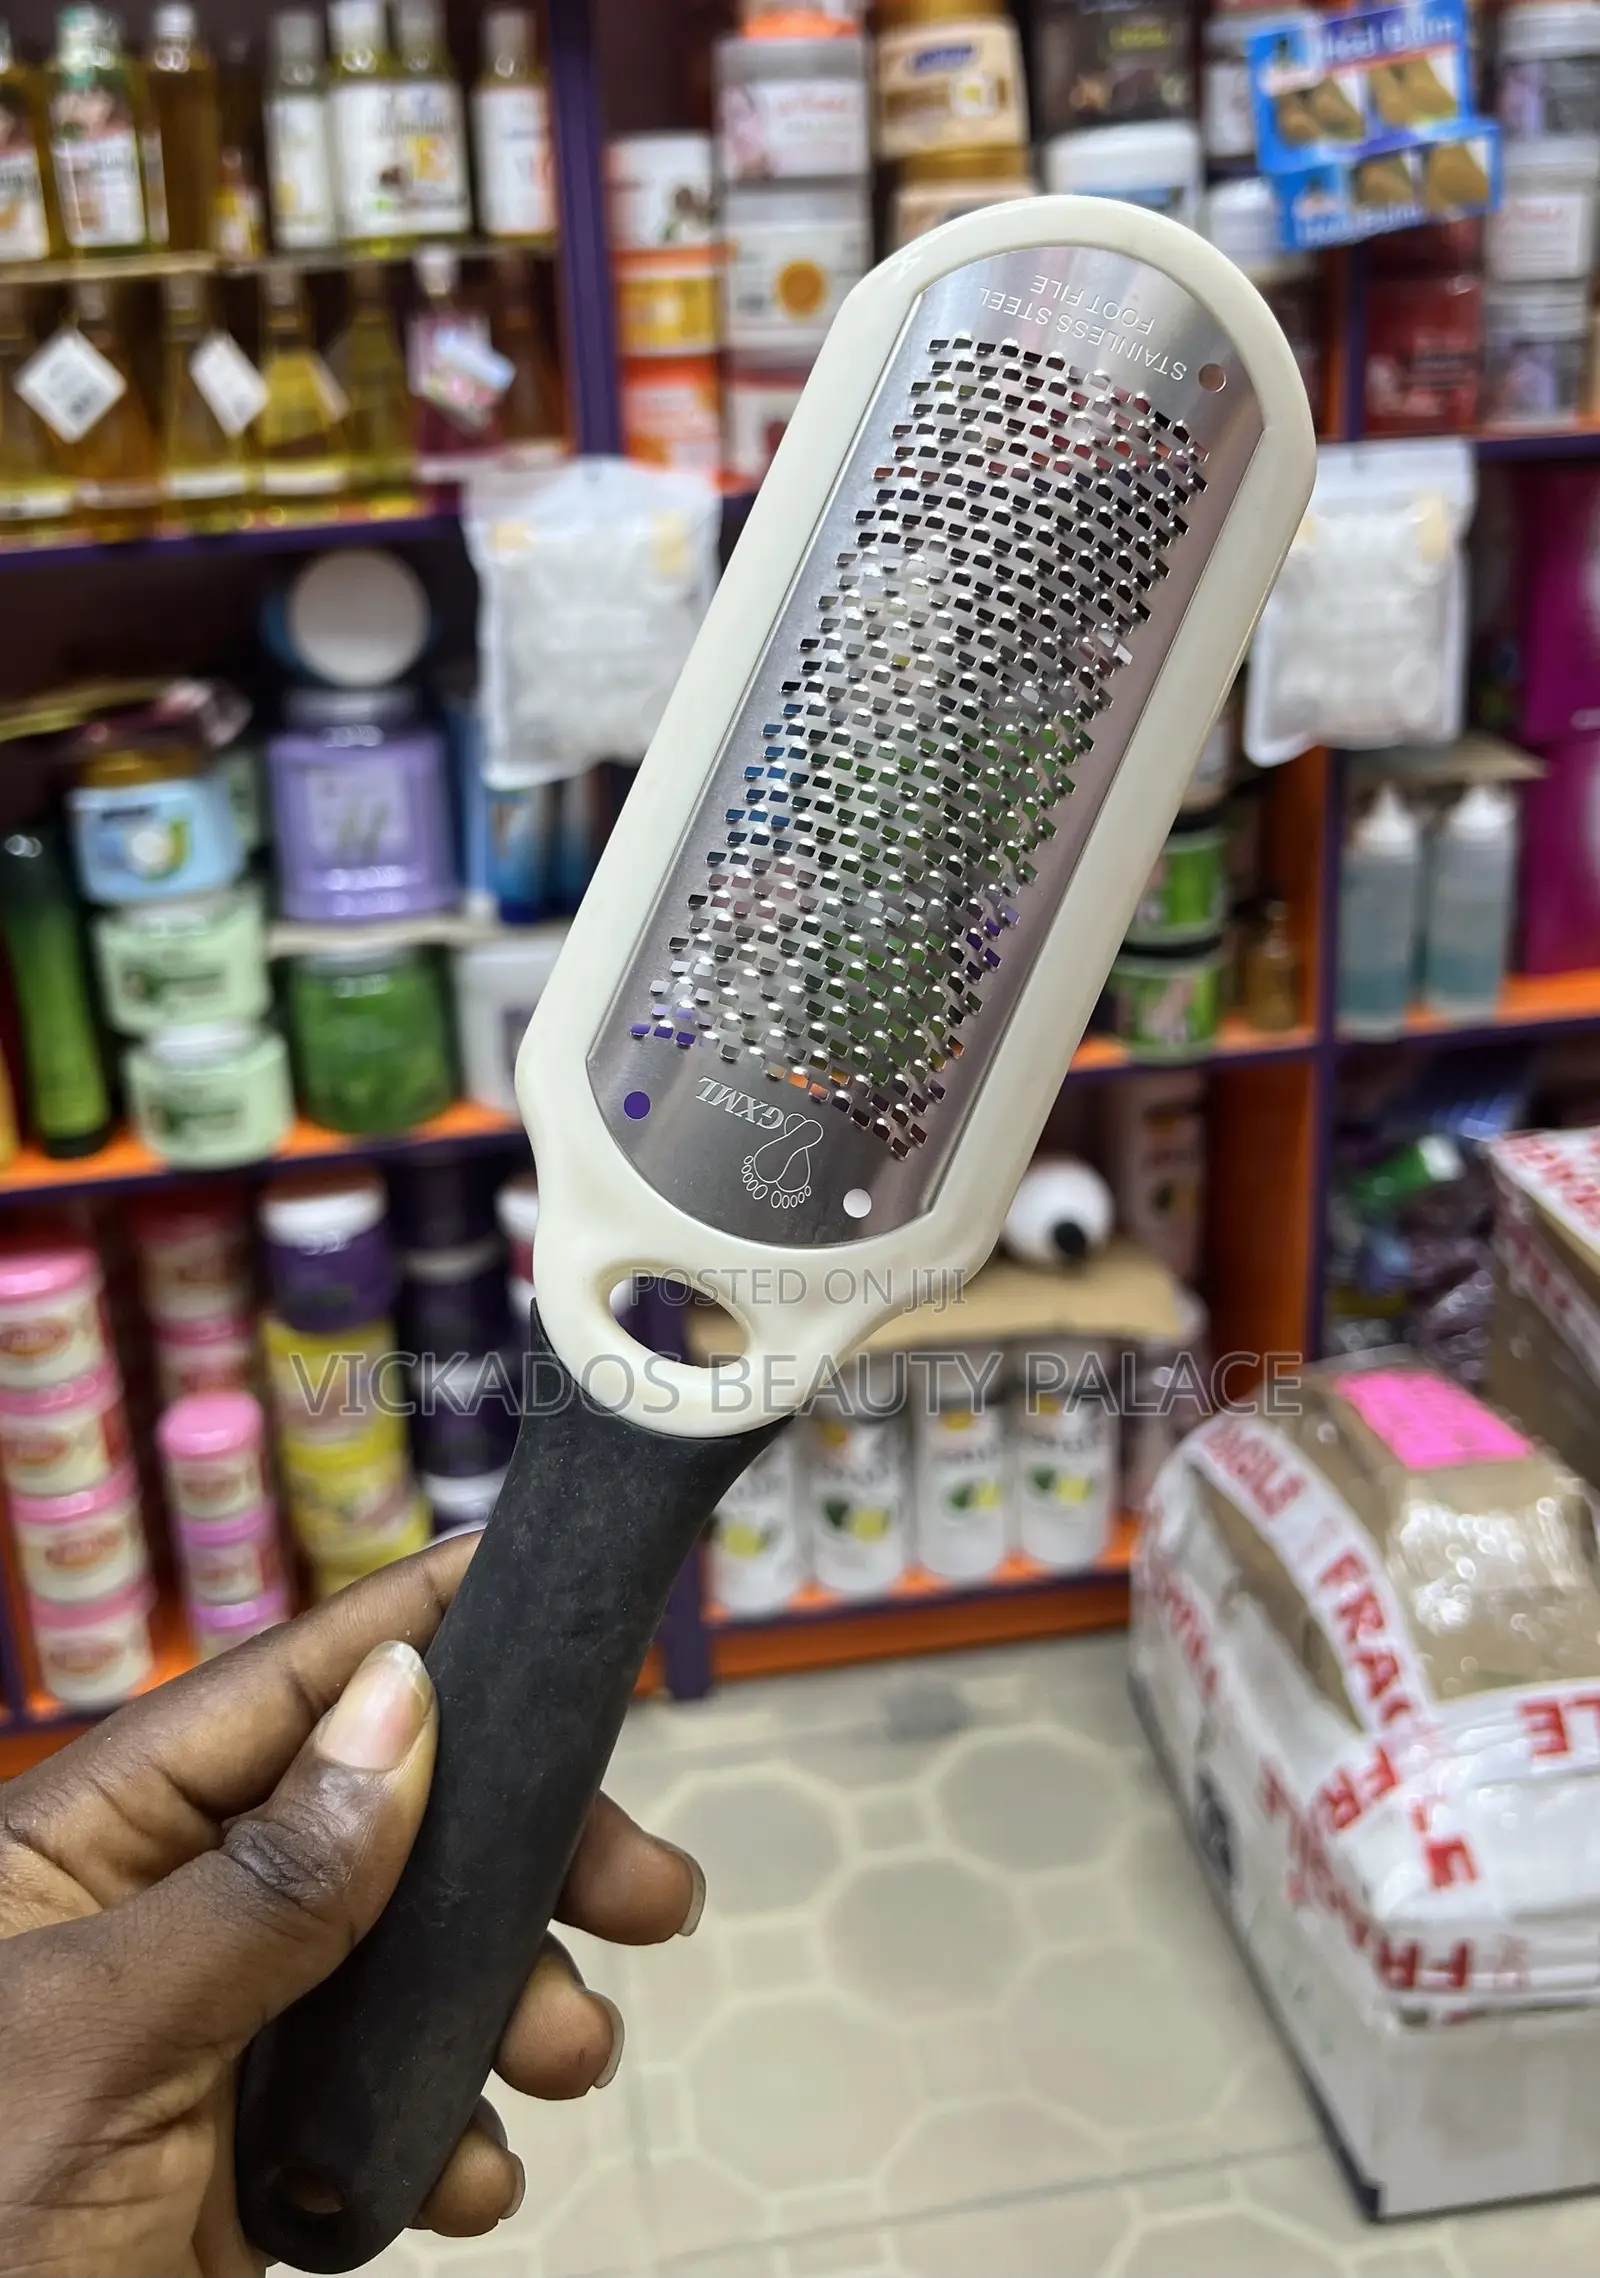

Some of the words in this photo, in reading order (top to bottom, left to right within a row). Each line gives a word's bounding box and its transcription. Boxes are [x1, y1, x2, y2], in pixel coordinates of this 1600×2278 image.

[979, 287, 1052, 326] STEEL
[1029, 274, 1085, 307] FILE
[1085, 294, 1156, 336] FOOT
[1055, 313, 1188, 381] STAINLESS
[695, 1075, 785, 1130] GXML
